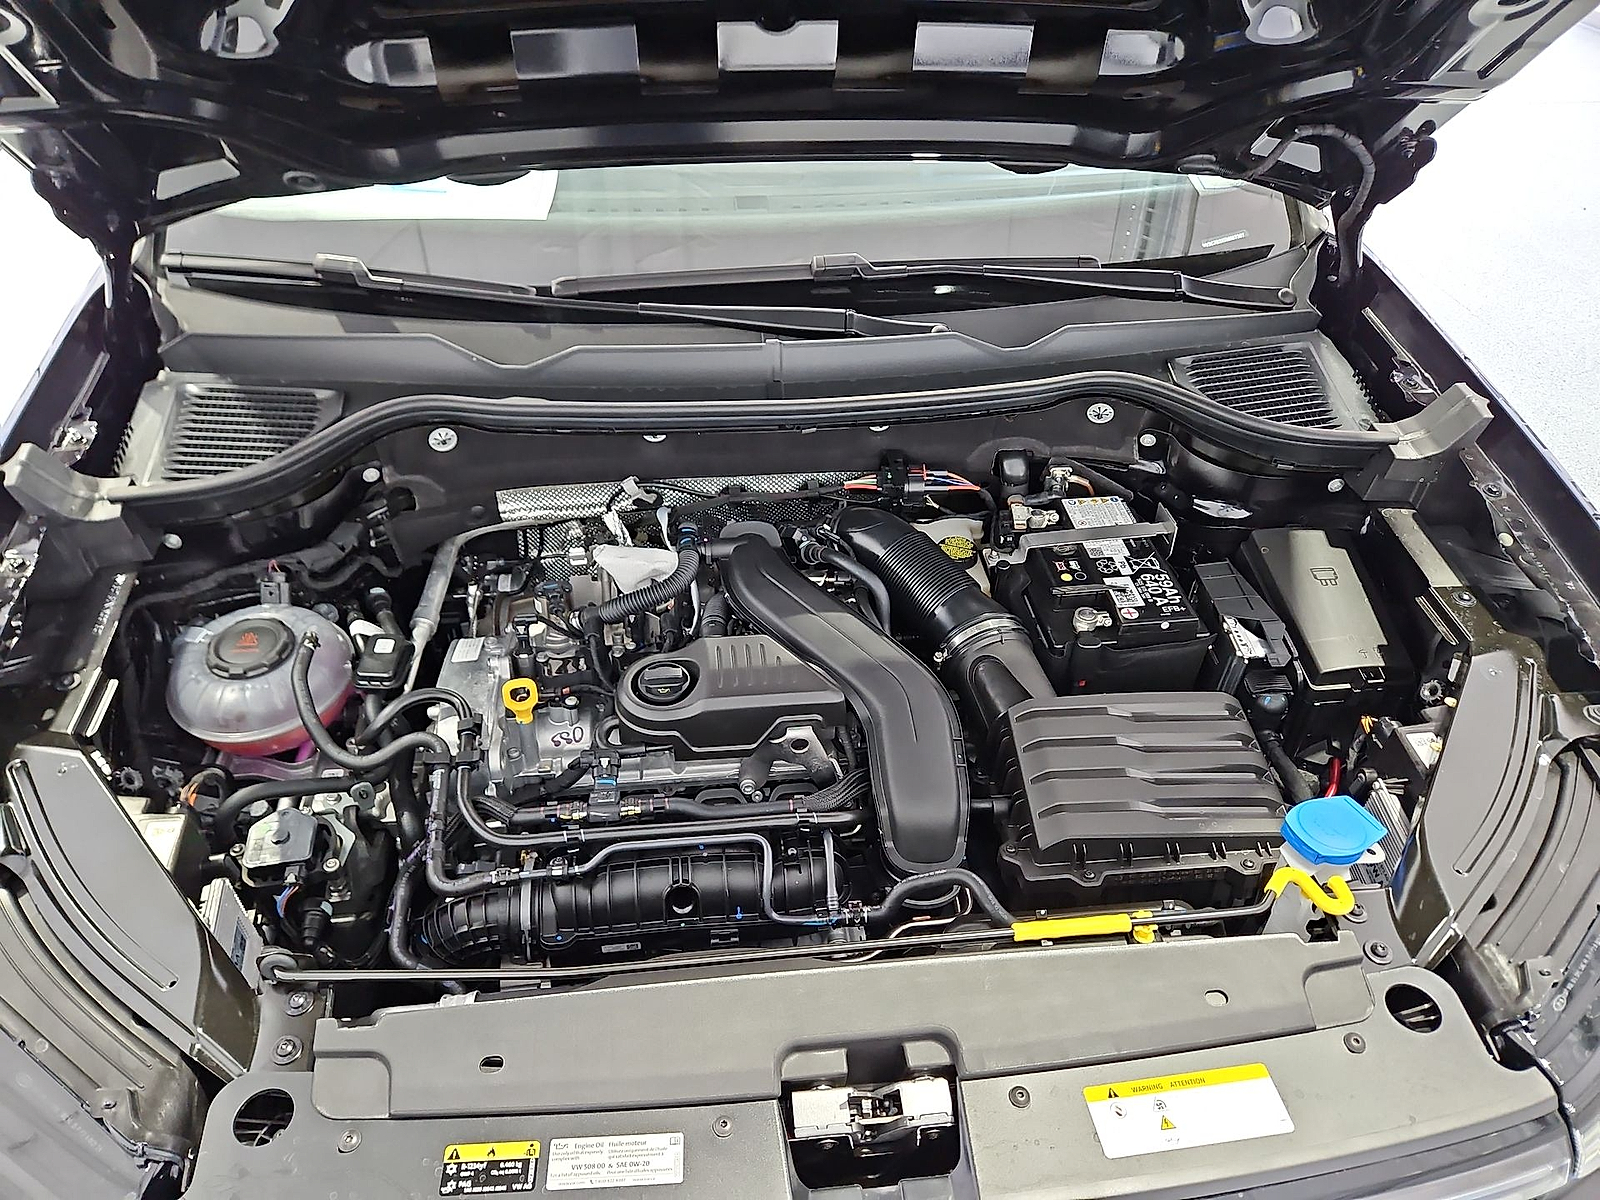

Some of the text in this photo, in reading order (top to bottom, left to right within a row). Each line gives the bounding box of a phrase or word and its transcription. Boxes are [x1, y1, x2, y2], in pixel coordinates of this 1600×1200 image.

[1140, 573, 1163, 595] 640
[1152, 596, 1169, 606] A
[1154, 573, 1182, 604] 59Ah
[1161, 605, 1187, 613] EFB+
[1130, 1077, 1206, 1093] WARNING ATTENTION
[574, 1142, 594, 1150] Engine
[583, 1163, 595, 1171] 508
[616, 1161, 628, 1169] SAE
[629, 1160, 650, 1168] 0W-20
